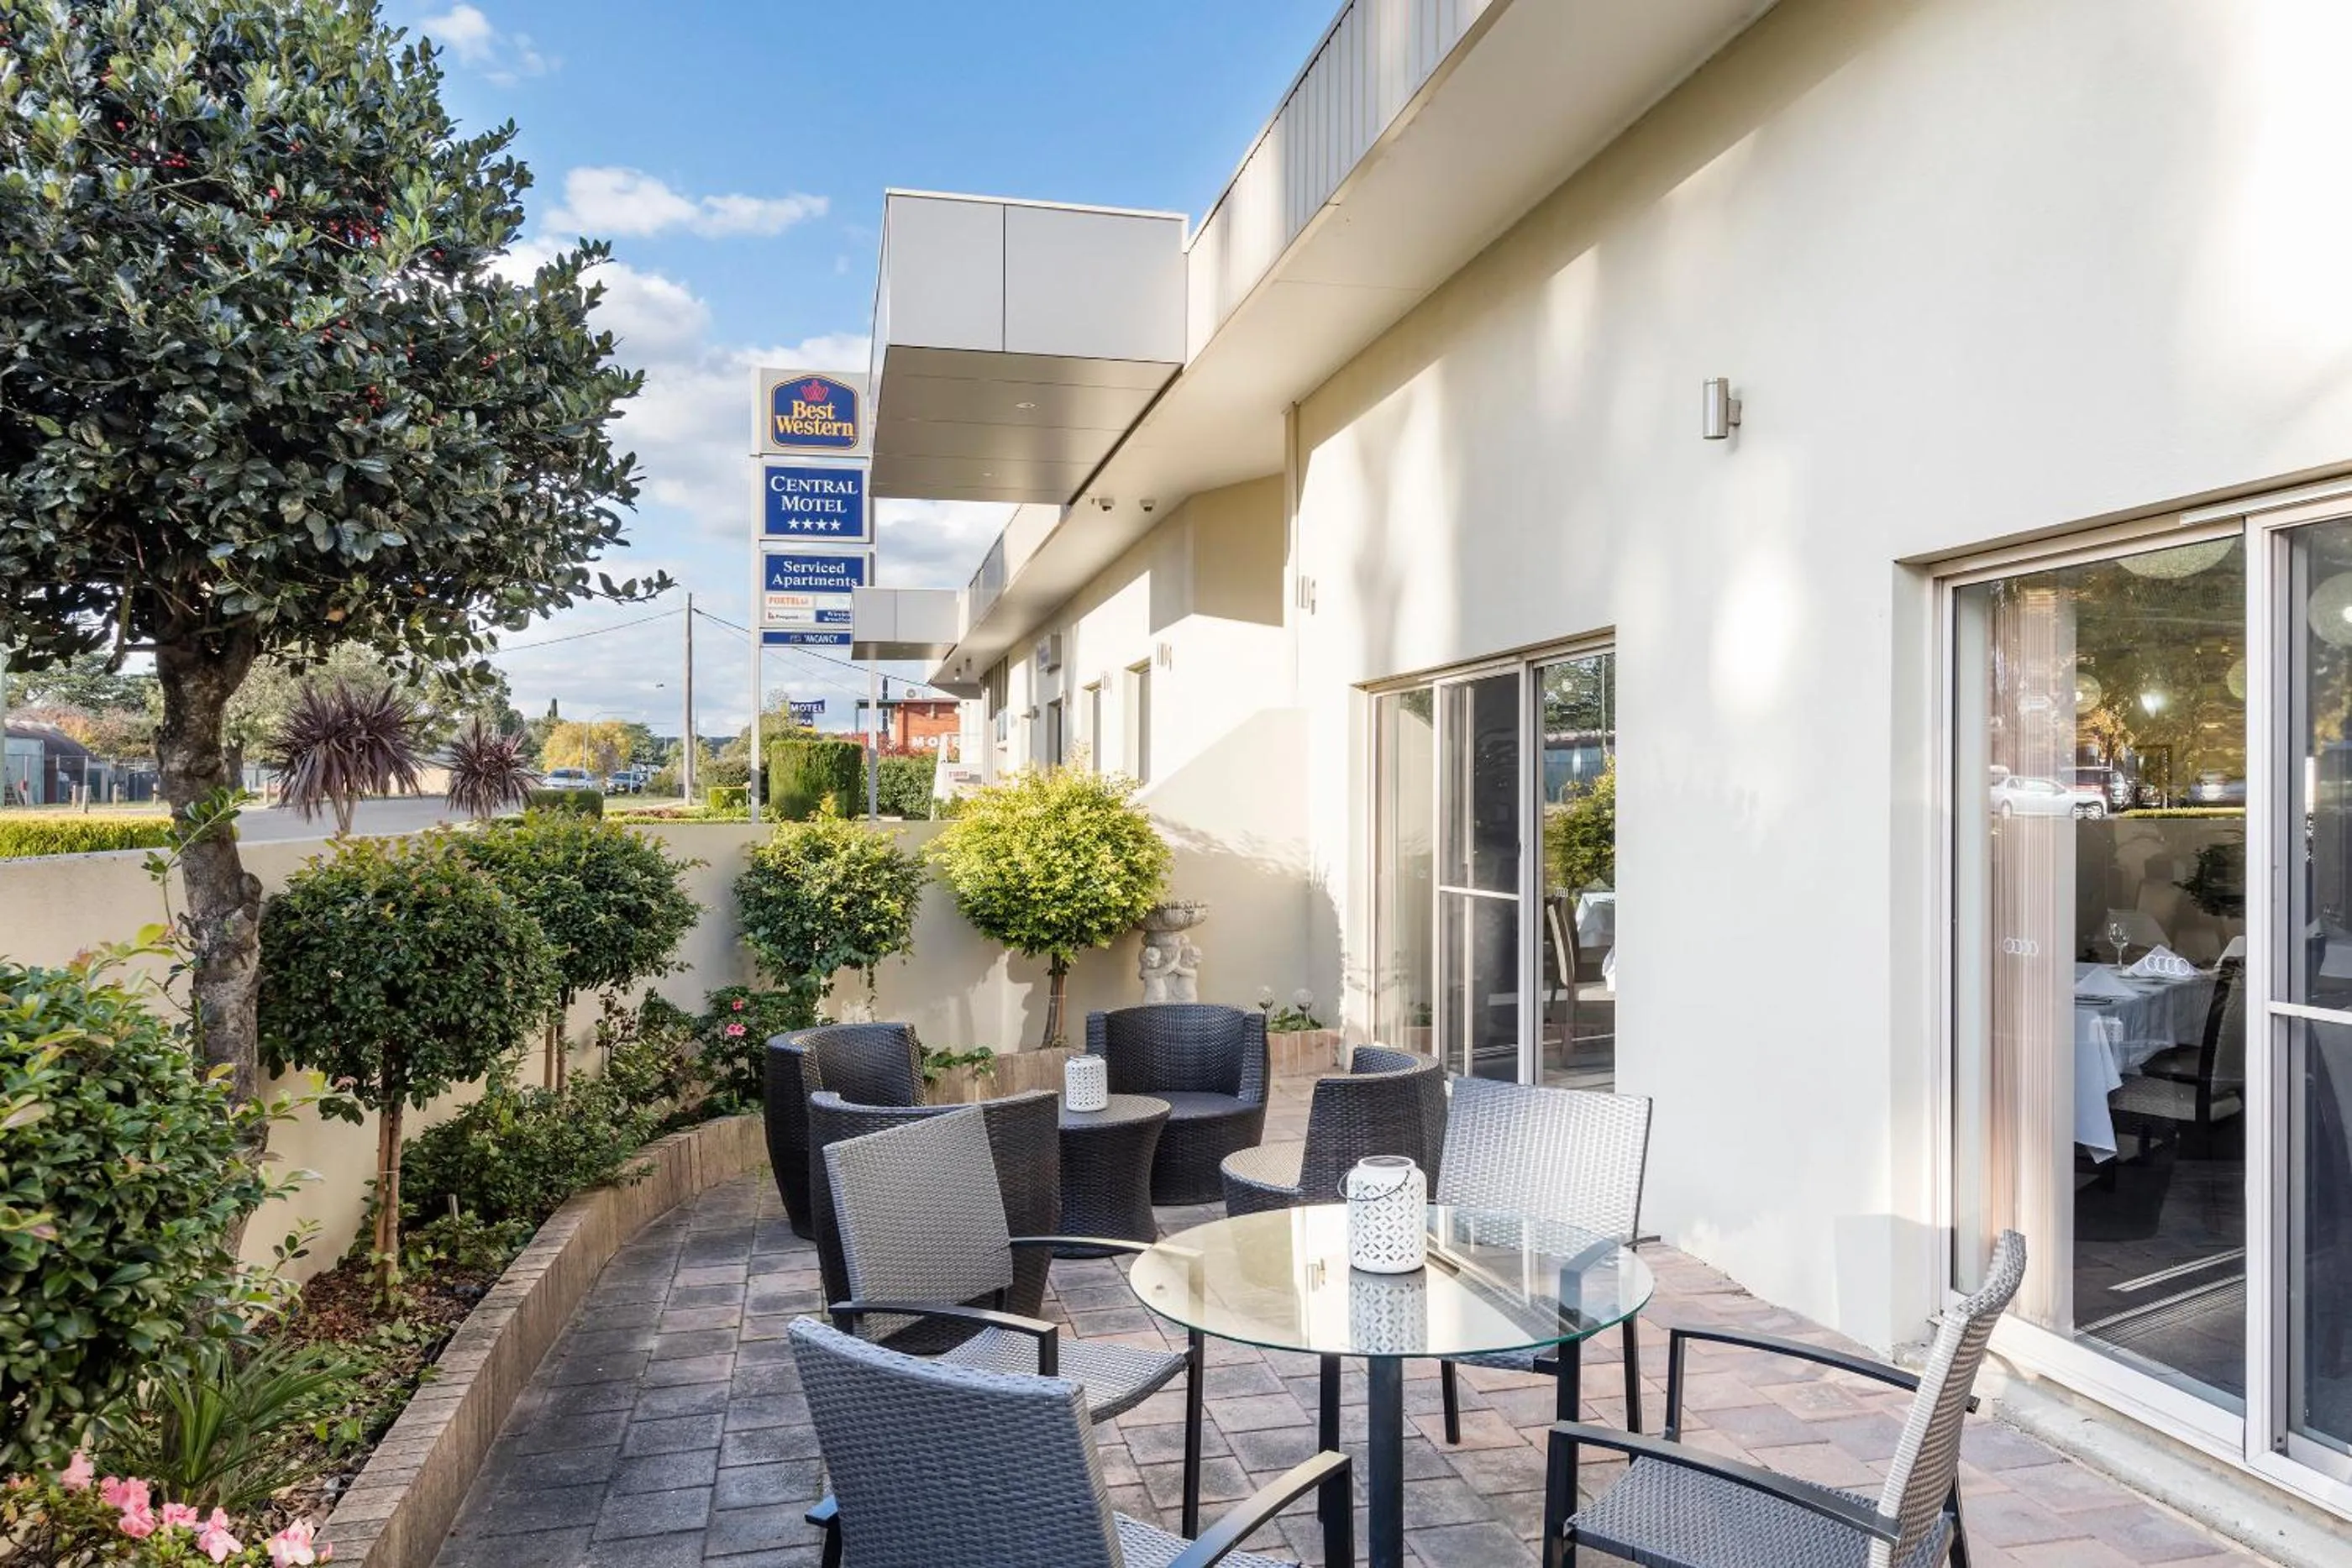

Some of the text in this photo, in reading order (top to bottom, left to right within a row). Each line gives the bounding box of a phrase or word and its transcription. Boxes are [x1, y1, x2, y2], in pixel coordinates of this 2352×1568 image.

[791, 400, 836, 420] Best
[775, 415, 854, 437] Western
[770, 475, 858, 495] CENTRAL
[781, 495, 848, 514] MOTEL
[783, 560, 845, 574] Serviced
[772, 574, 858, 588] Apartments
[791, 703, 823, 713] MOTEL
